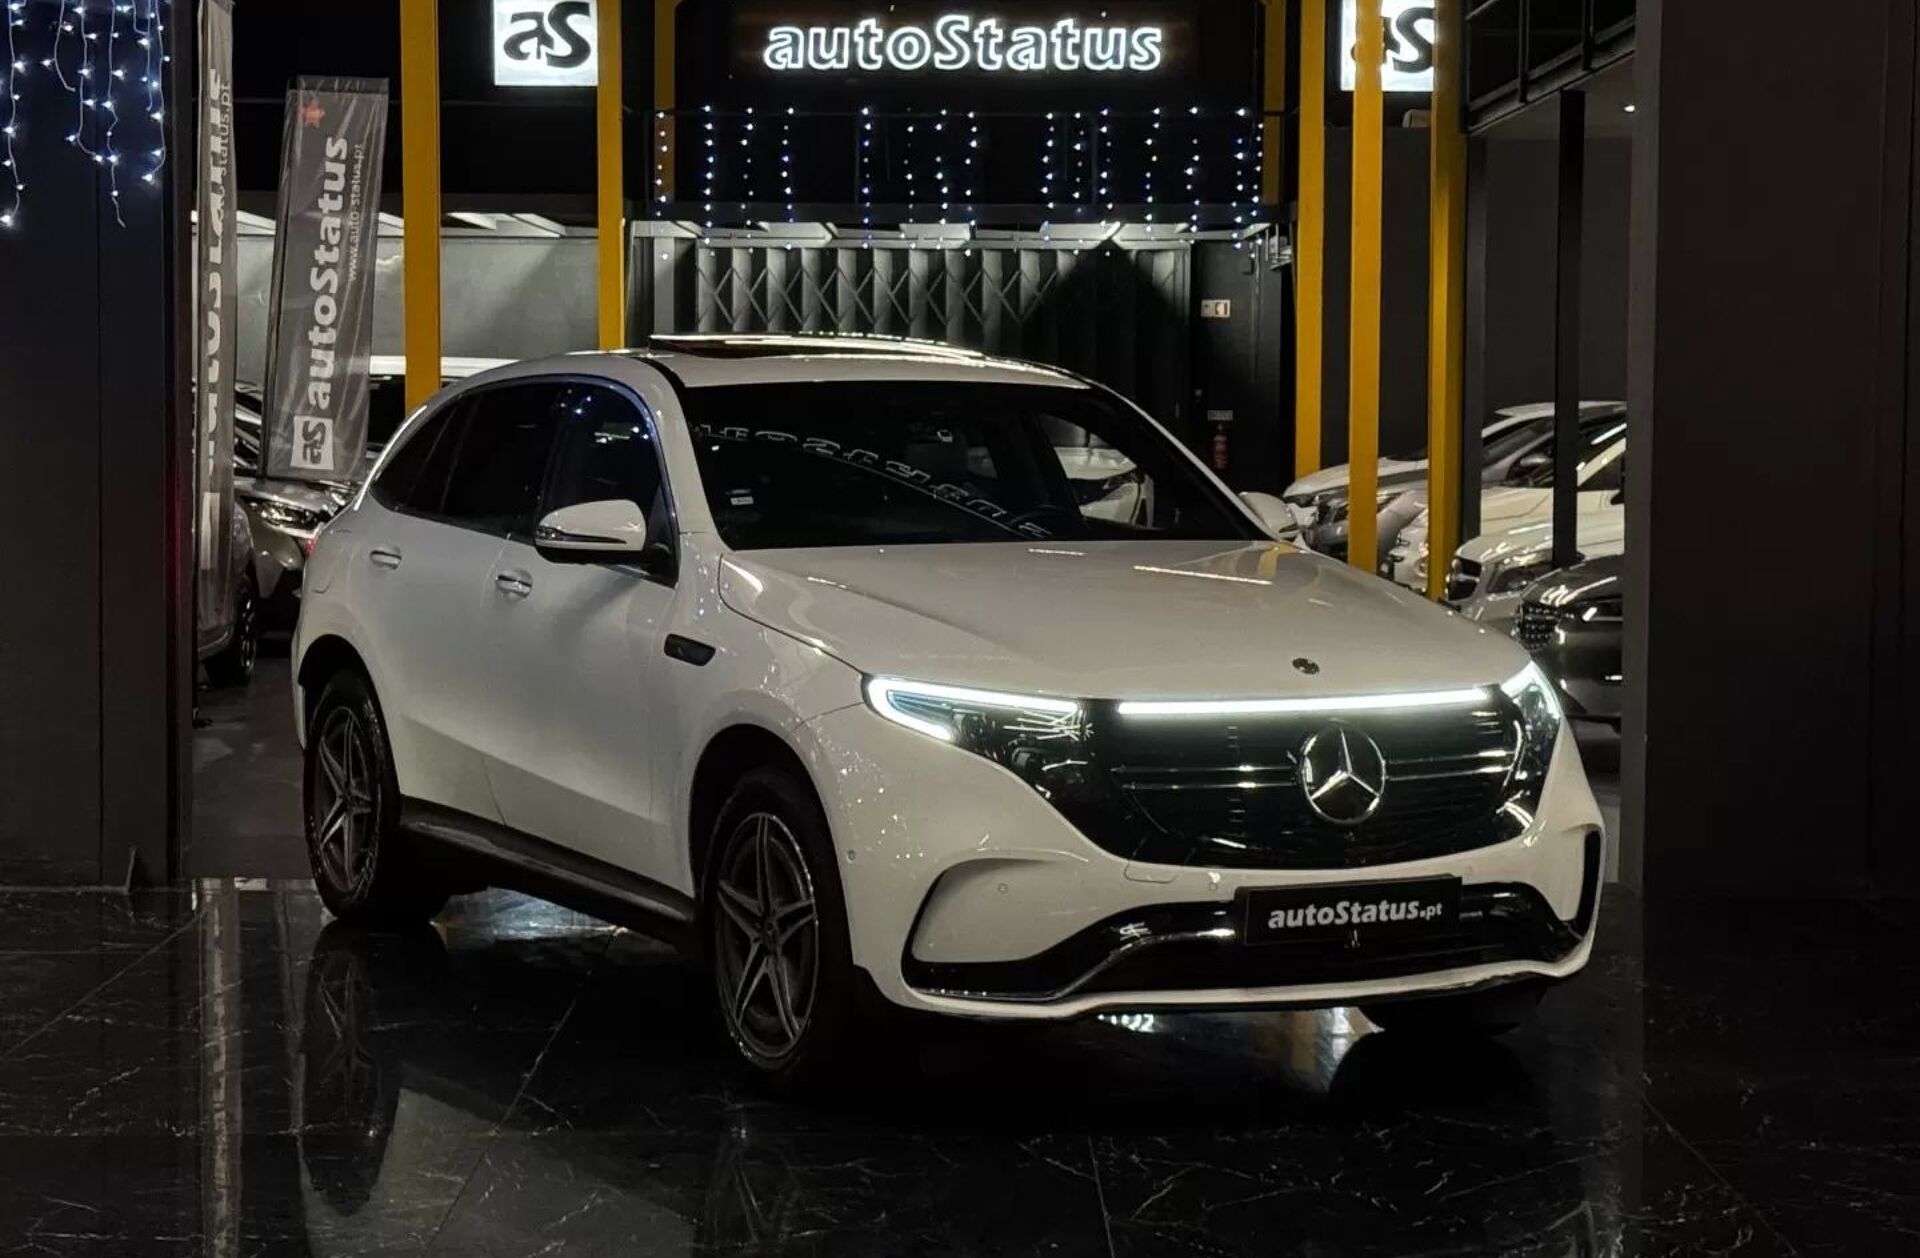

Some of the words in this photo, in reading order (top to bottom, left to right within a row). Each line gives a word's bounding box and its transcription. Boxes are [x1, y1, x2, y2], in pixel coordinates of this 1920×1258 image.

[503, 1, 591, 69] aS
[763, 14, 1162, 71] autoStatus
[308, 136, 348, 410] autoStatus
[1267, 900, 1443, 929] autoStatus.pt
